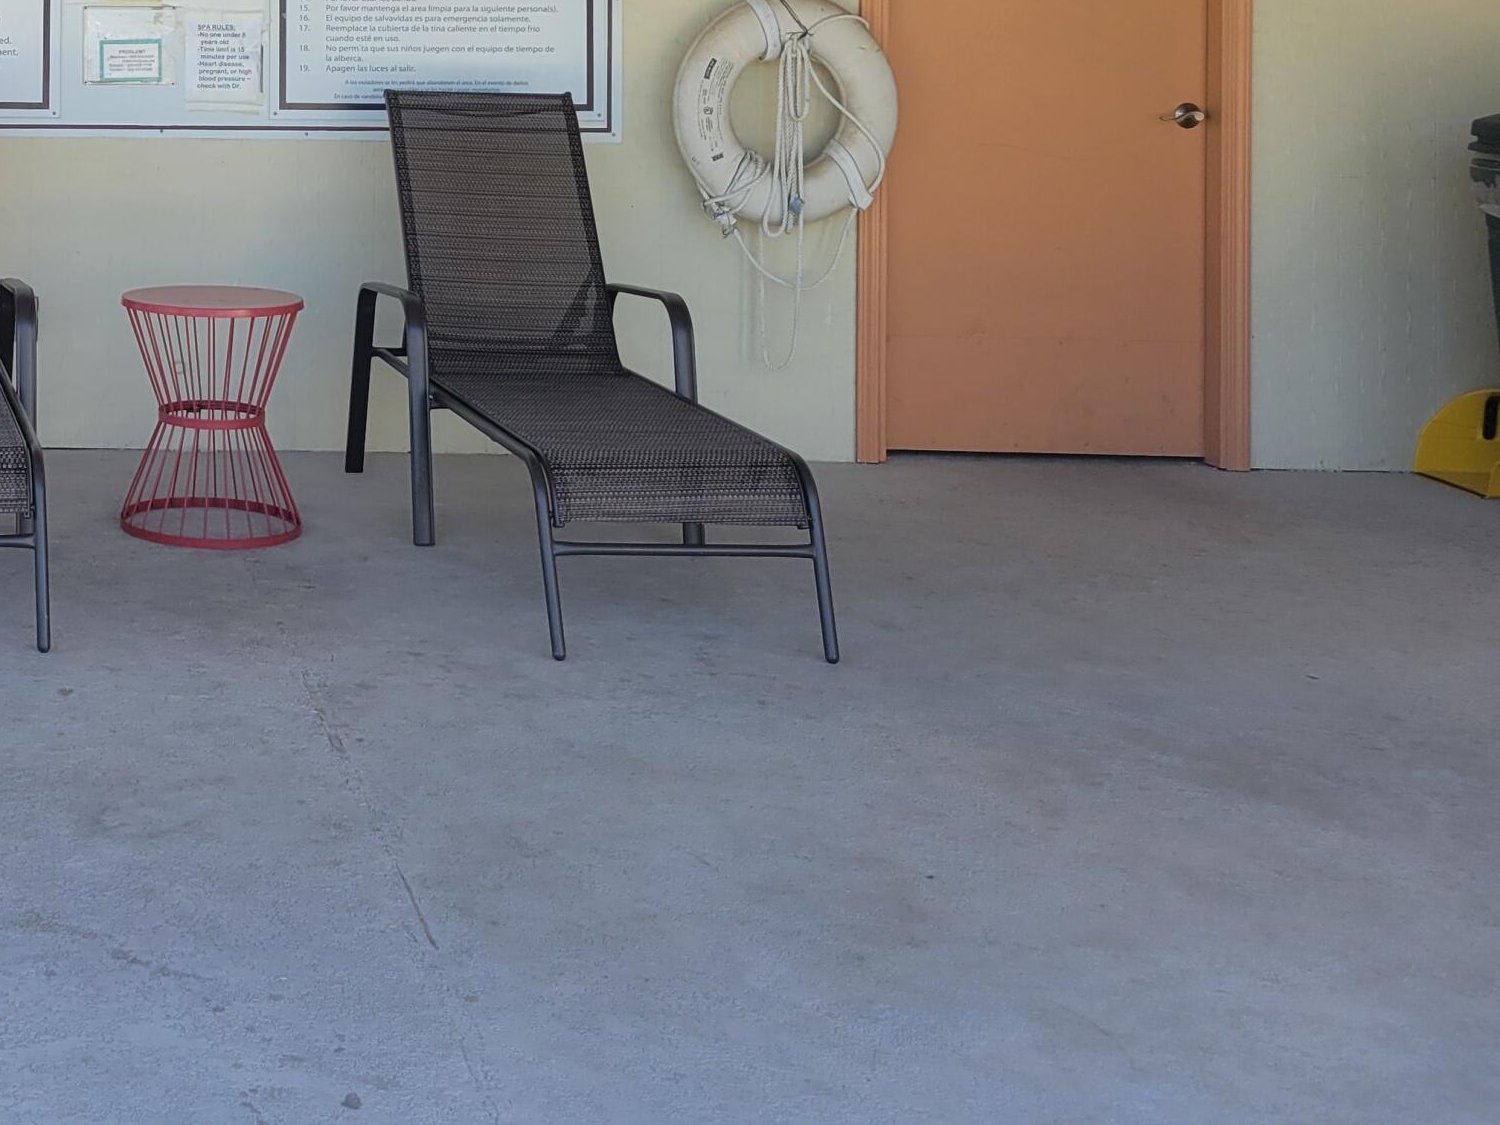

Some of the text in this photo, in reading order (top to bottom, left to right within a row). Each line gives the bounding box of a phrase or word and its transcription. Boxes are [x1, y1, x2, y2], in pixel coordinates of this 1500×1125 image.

[300, 63, 416, 74] 19. Apagen las luces al salir.
